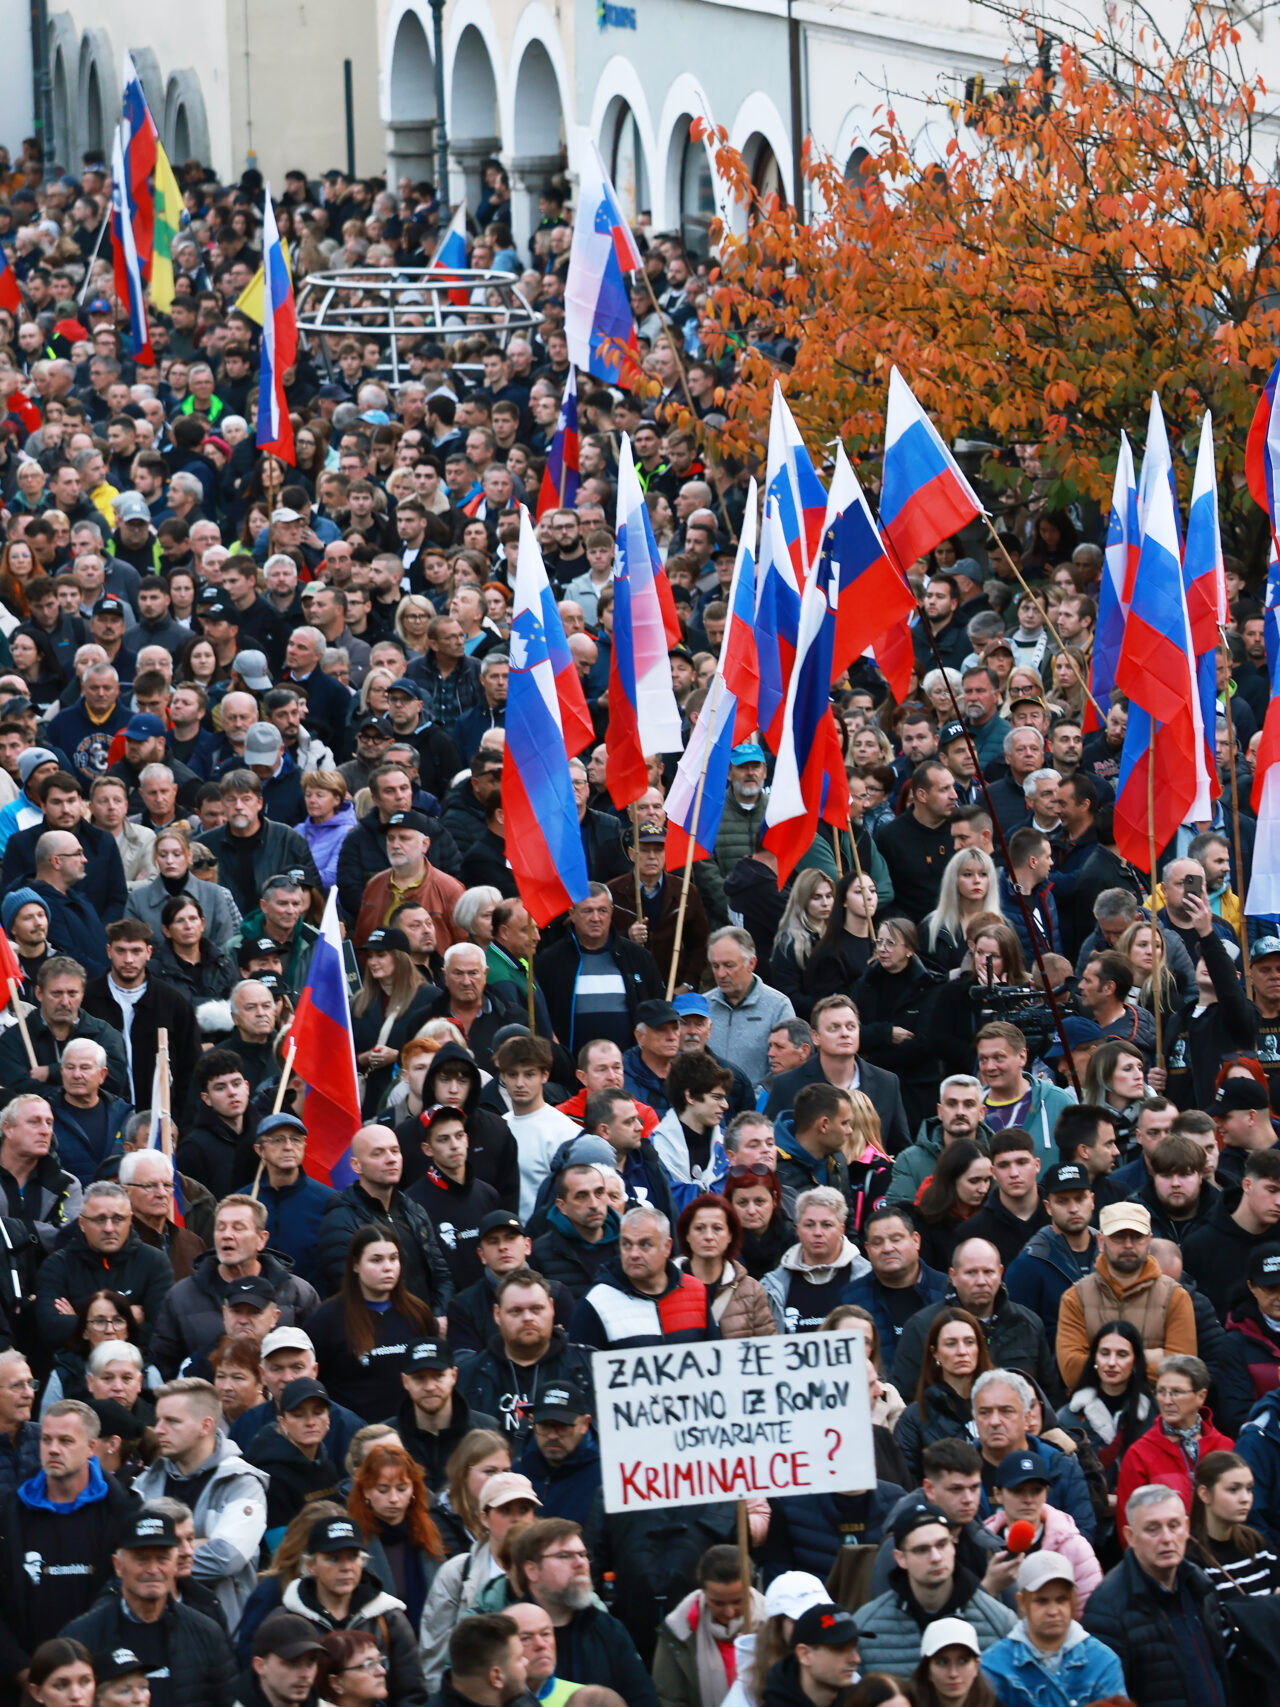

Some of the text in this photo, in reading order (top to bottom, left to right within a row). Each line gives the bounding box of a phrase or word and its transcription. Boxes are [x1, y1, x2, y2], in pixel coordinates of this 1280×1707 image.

[608, 1337, 856, 1389] ZAKAJ ŽE 30 LET
[613, 1390, 726, 1430] NAČRTNO
[743, 1389, 765, 1415] IZ
[674, 1420, 793, 1451] USTVARJATE
[619, 1428, 843, 1505] KRIMINALCE ?
